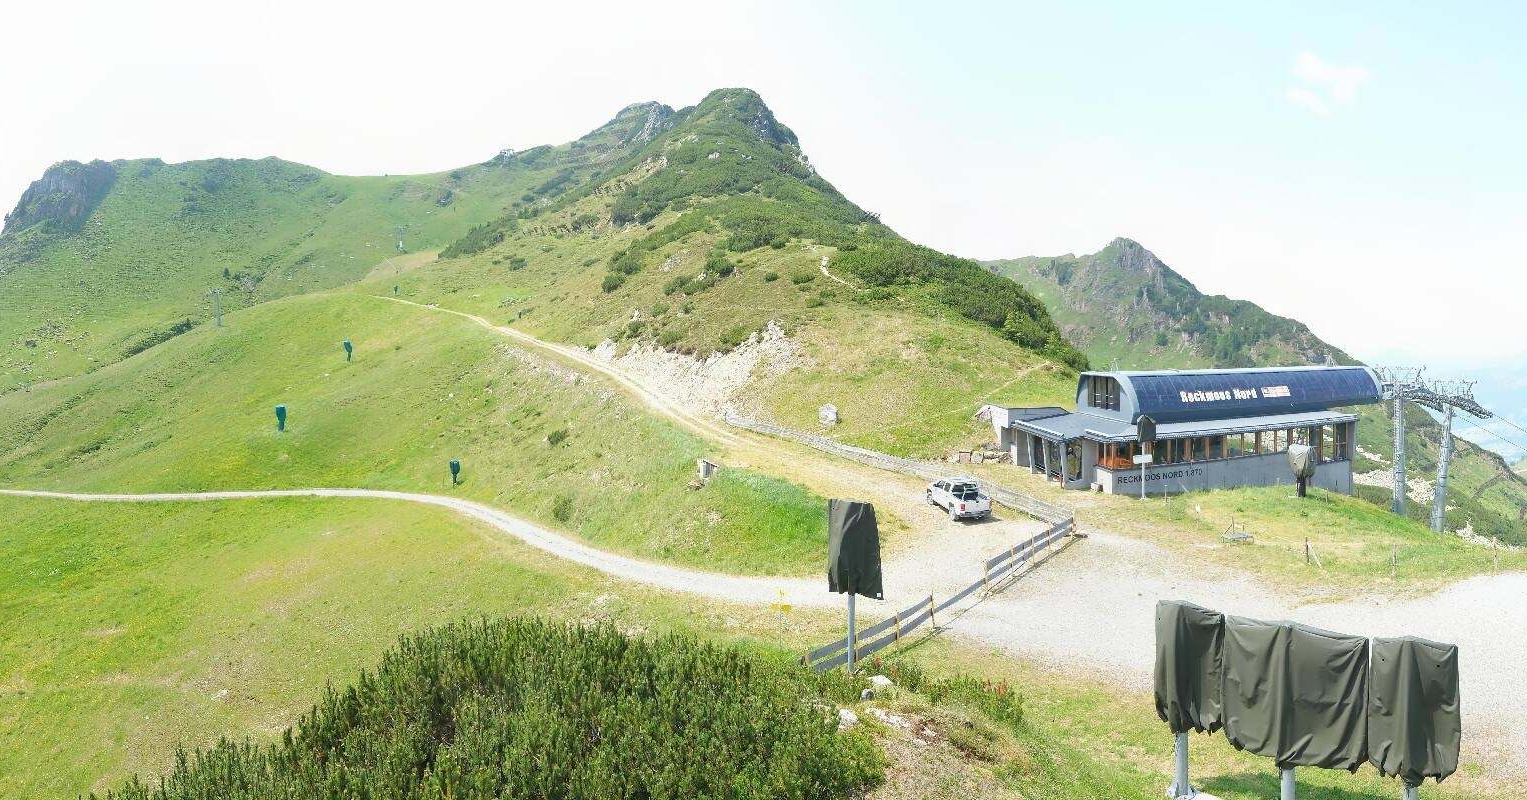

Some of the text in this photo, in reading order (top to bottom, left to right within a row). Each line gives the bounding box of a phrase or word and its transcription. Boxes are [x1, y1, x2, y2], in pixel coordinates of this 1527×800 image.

[1180, 390, 1231, 402] Reckmoos
[1233, 388, 1258, 400] Nord
[1162, 470, 1183, 480] NORD
